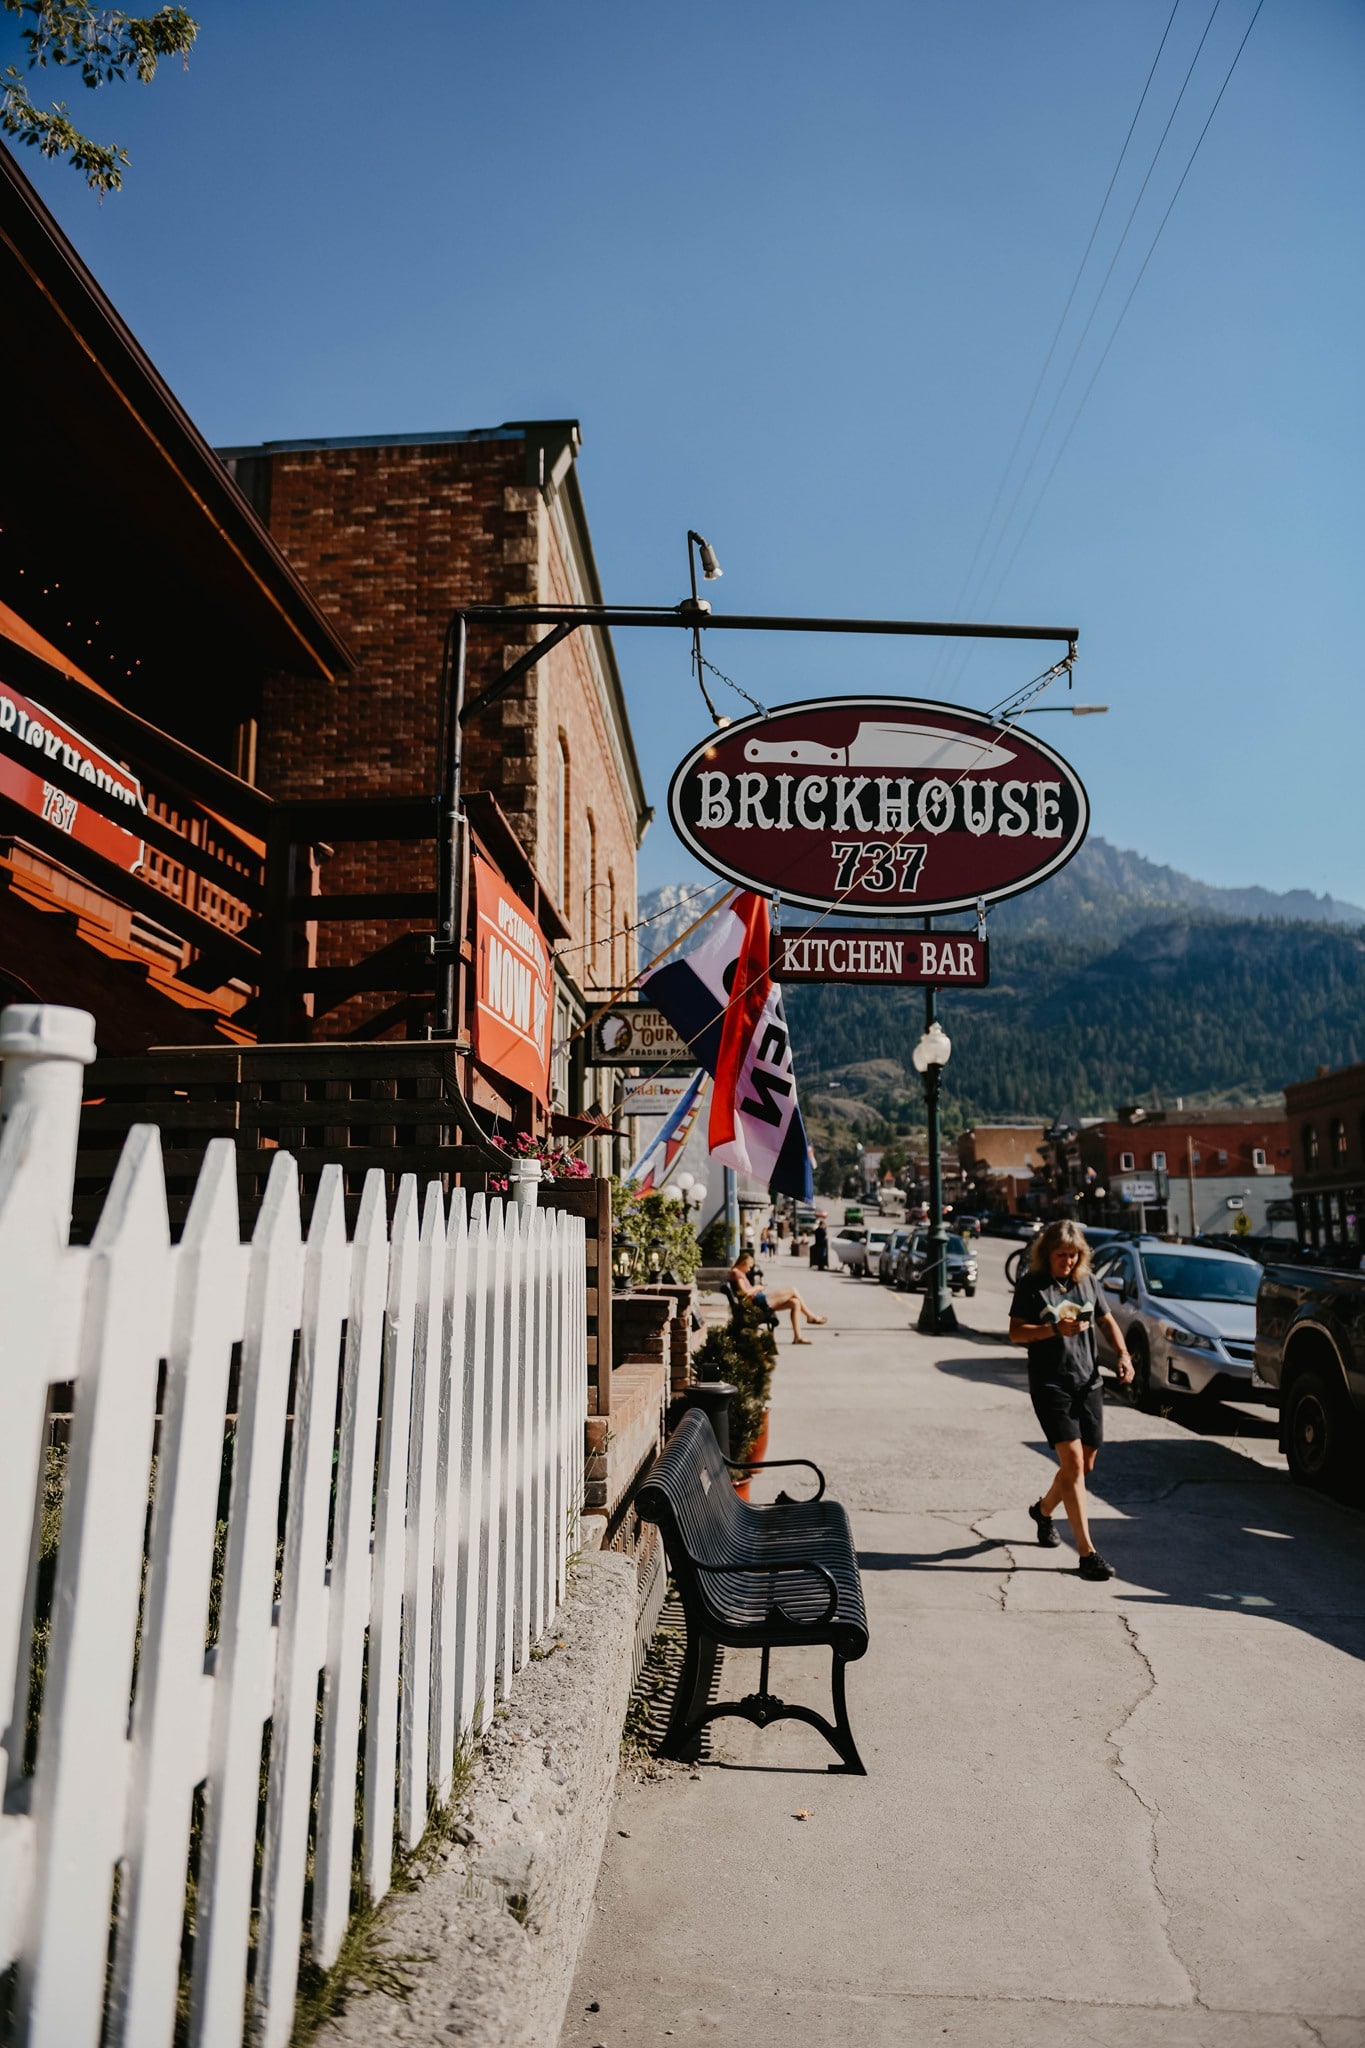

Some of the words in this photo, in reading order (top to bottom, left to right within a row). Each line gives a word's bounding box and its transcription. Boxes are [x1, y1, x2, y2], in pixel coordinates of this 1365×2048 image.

[41, 781, 77, 834] 737
[696, 771, 1064, 839] BRICKHOUSE
[831, 841, 927, 893] 737
[498, 896, 533, 957] UPSTAIRS
[782, 938, 904, 974] KITCHEN
[920, 942, 976, 976] BAR
[489, 934, 532, 1034] NOW
[632, 1014, 671, 1032] CHIE
